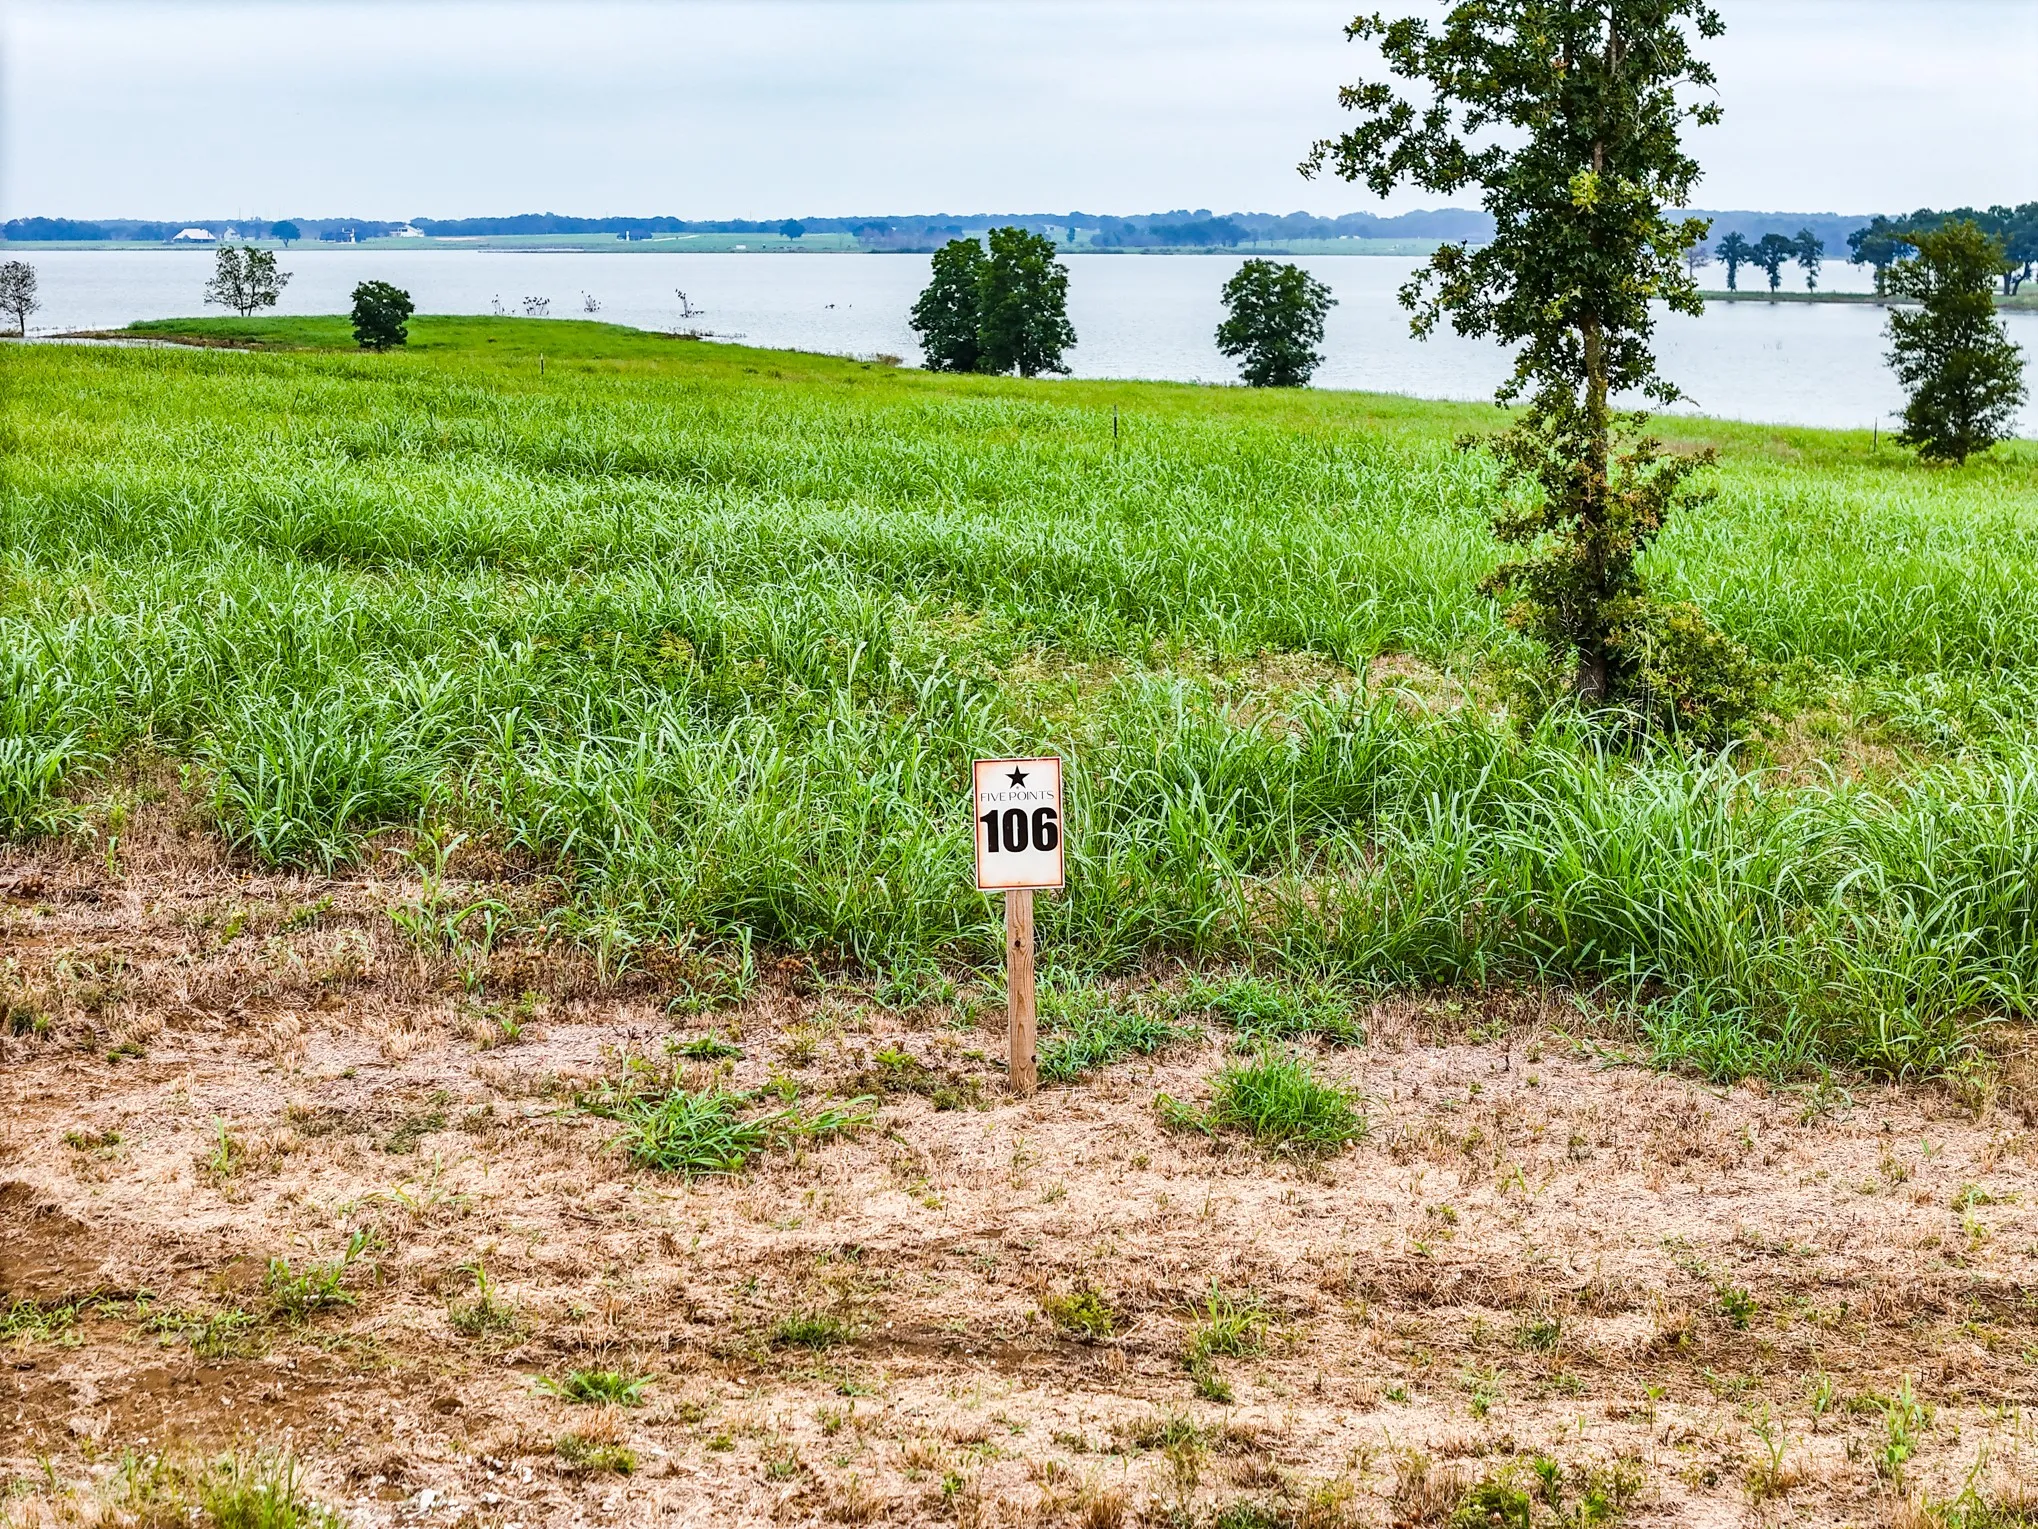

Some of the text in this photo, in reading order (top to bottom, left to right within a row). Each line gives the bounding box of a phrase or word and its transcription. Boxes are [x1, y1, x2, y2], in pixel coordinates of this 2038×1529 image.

[980, 790, 1055, 802] FIVE POINTS
[980, 807, 1058, 853] 106
